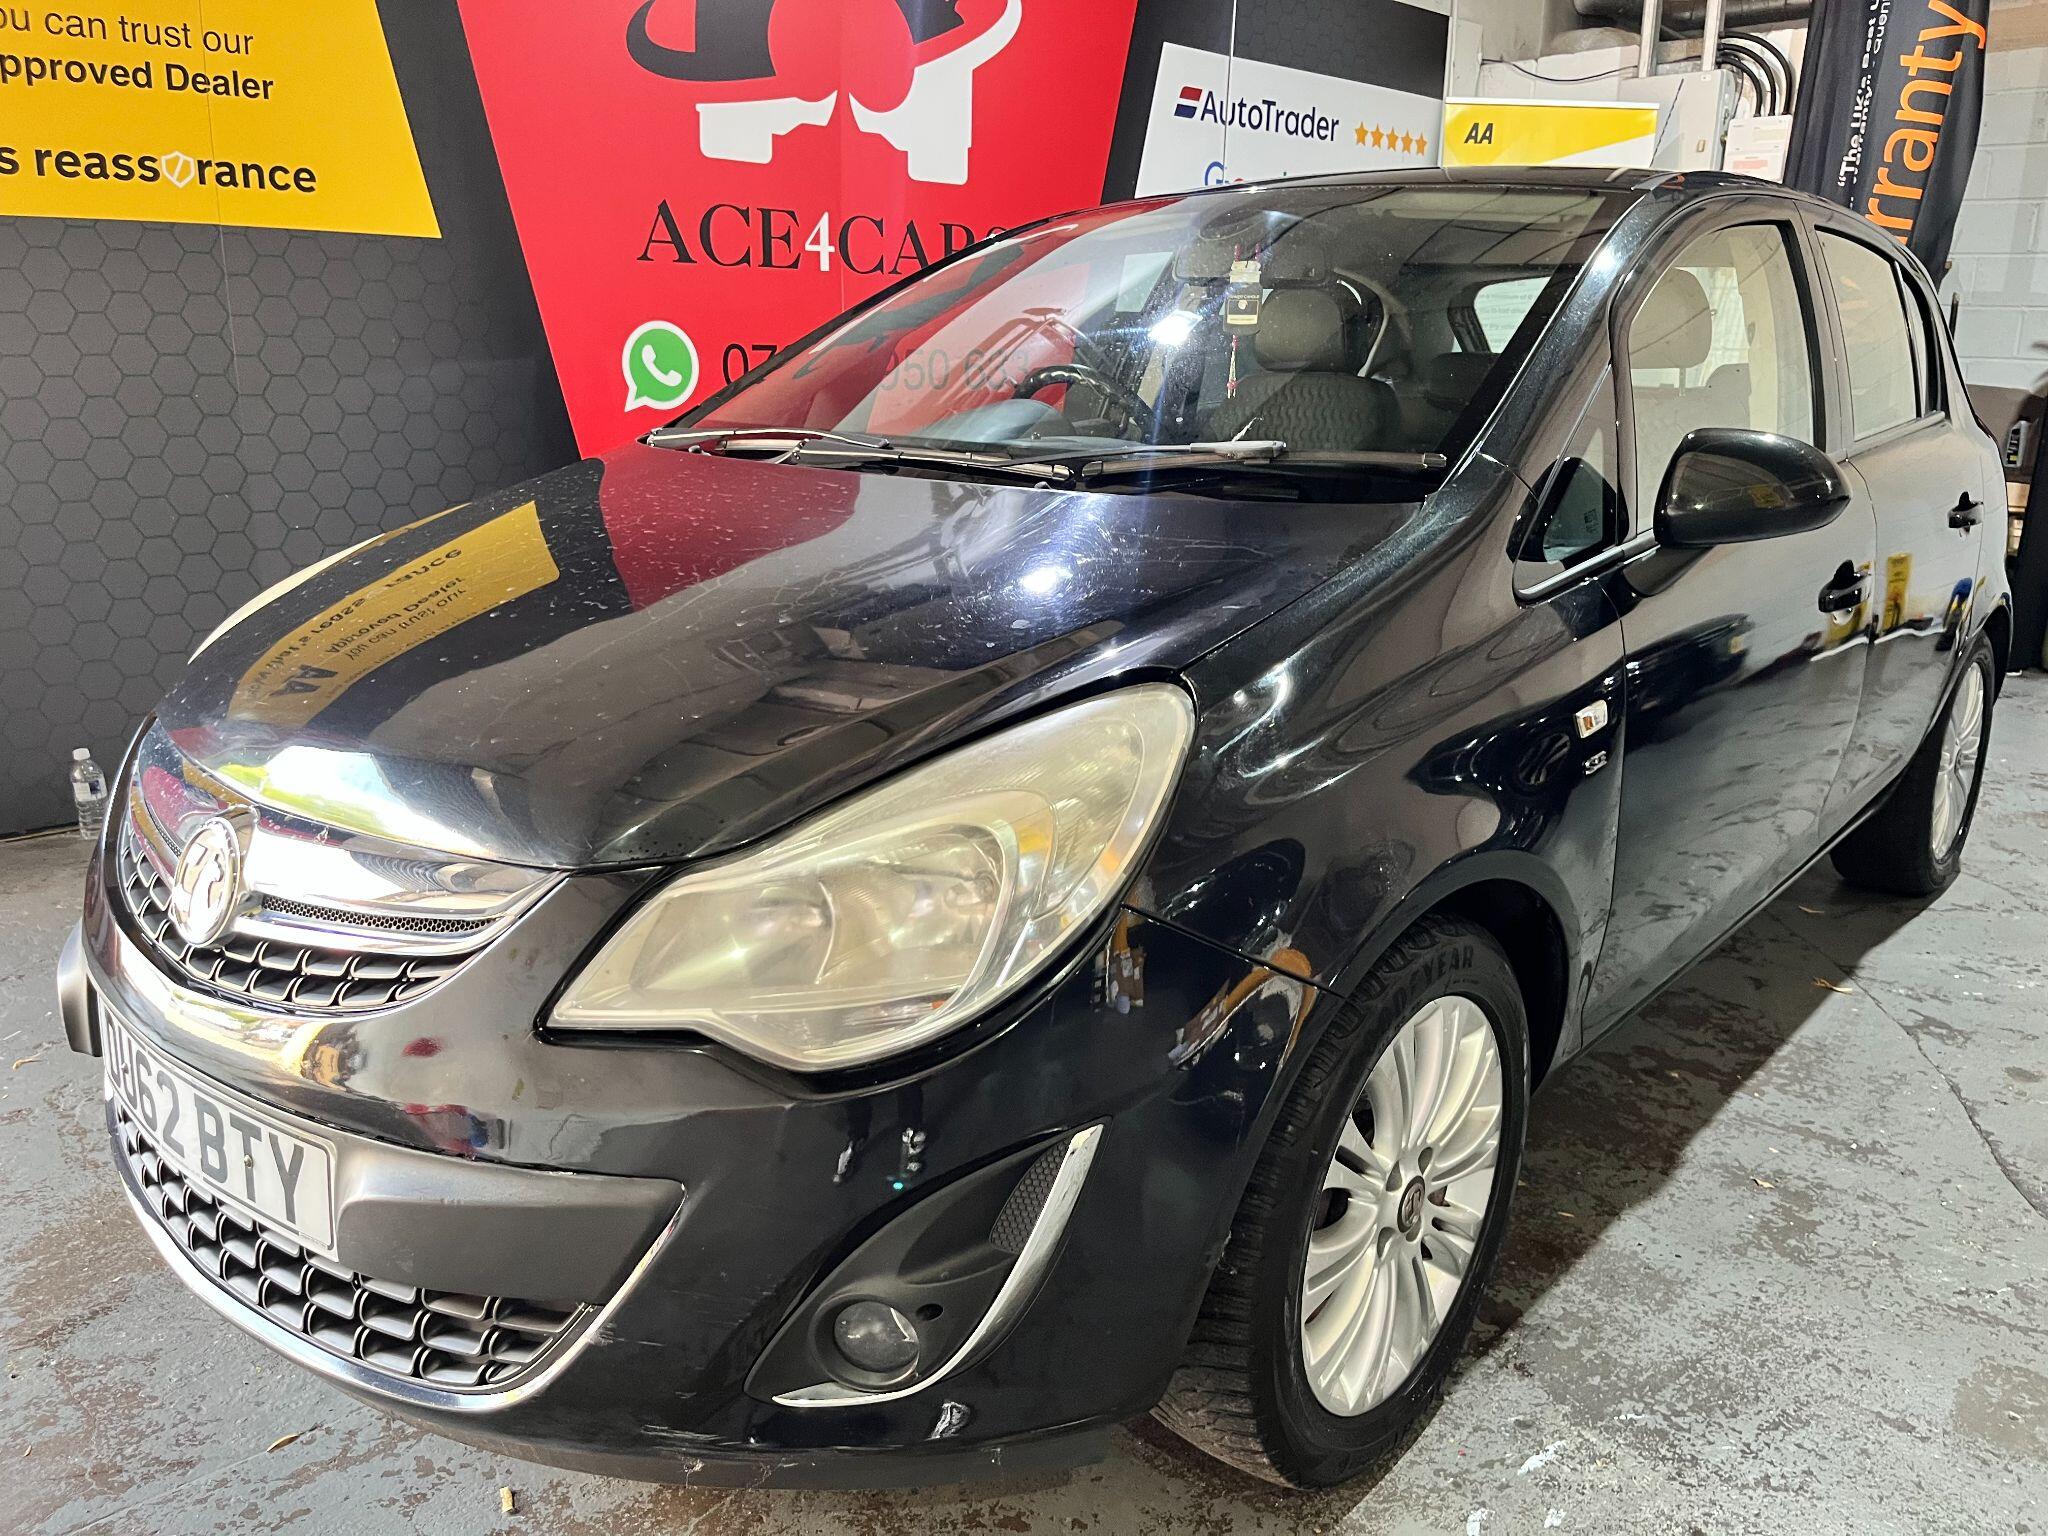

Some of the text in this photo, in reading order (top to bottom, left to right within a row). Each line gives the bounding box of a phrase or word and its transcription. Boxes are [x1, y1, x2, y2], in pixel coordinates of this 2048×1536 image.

[45, 11, 107, 40] can
[118, 15, 192, 49] trust
[203, 30, 253, 55] our
[165, 62, 274, 100] Dealer
[1200, 90, 1340, 142] AutoTrader
[1464, 122, 1494, 145] AA
[1864, 0, 1986, 246] rranty
[636, 198, 1007, 275] ACE4CAR
[193, 1091, 305, 1226] BTY
